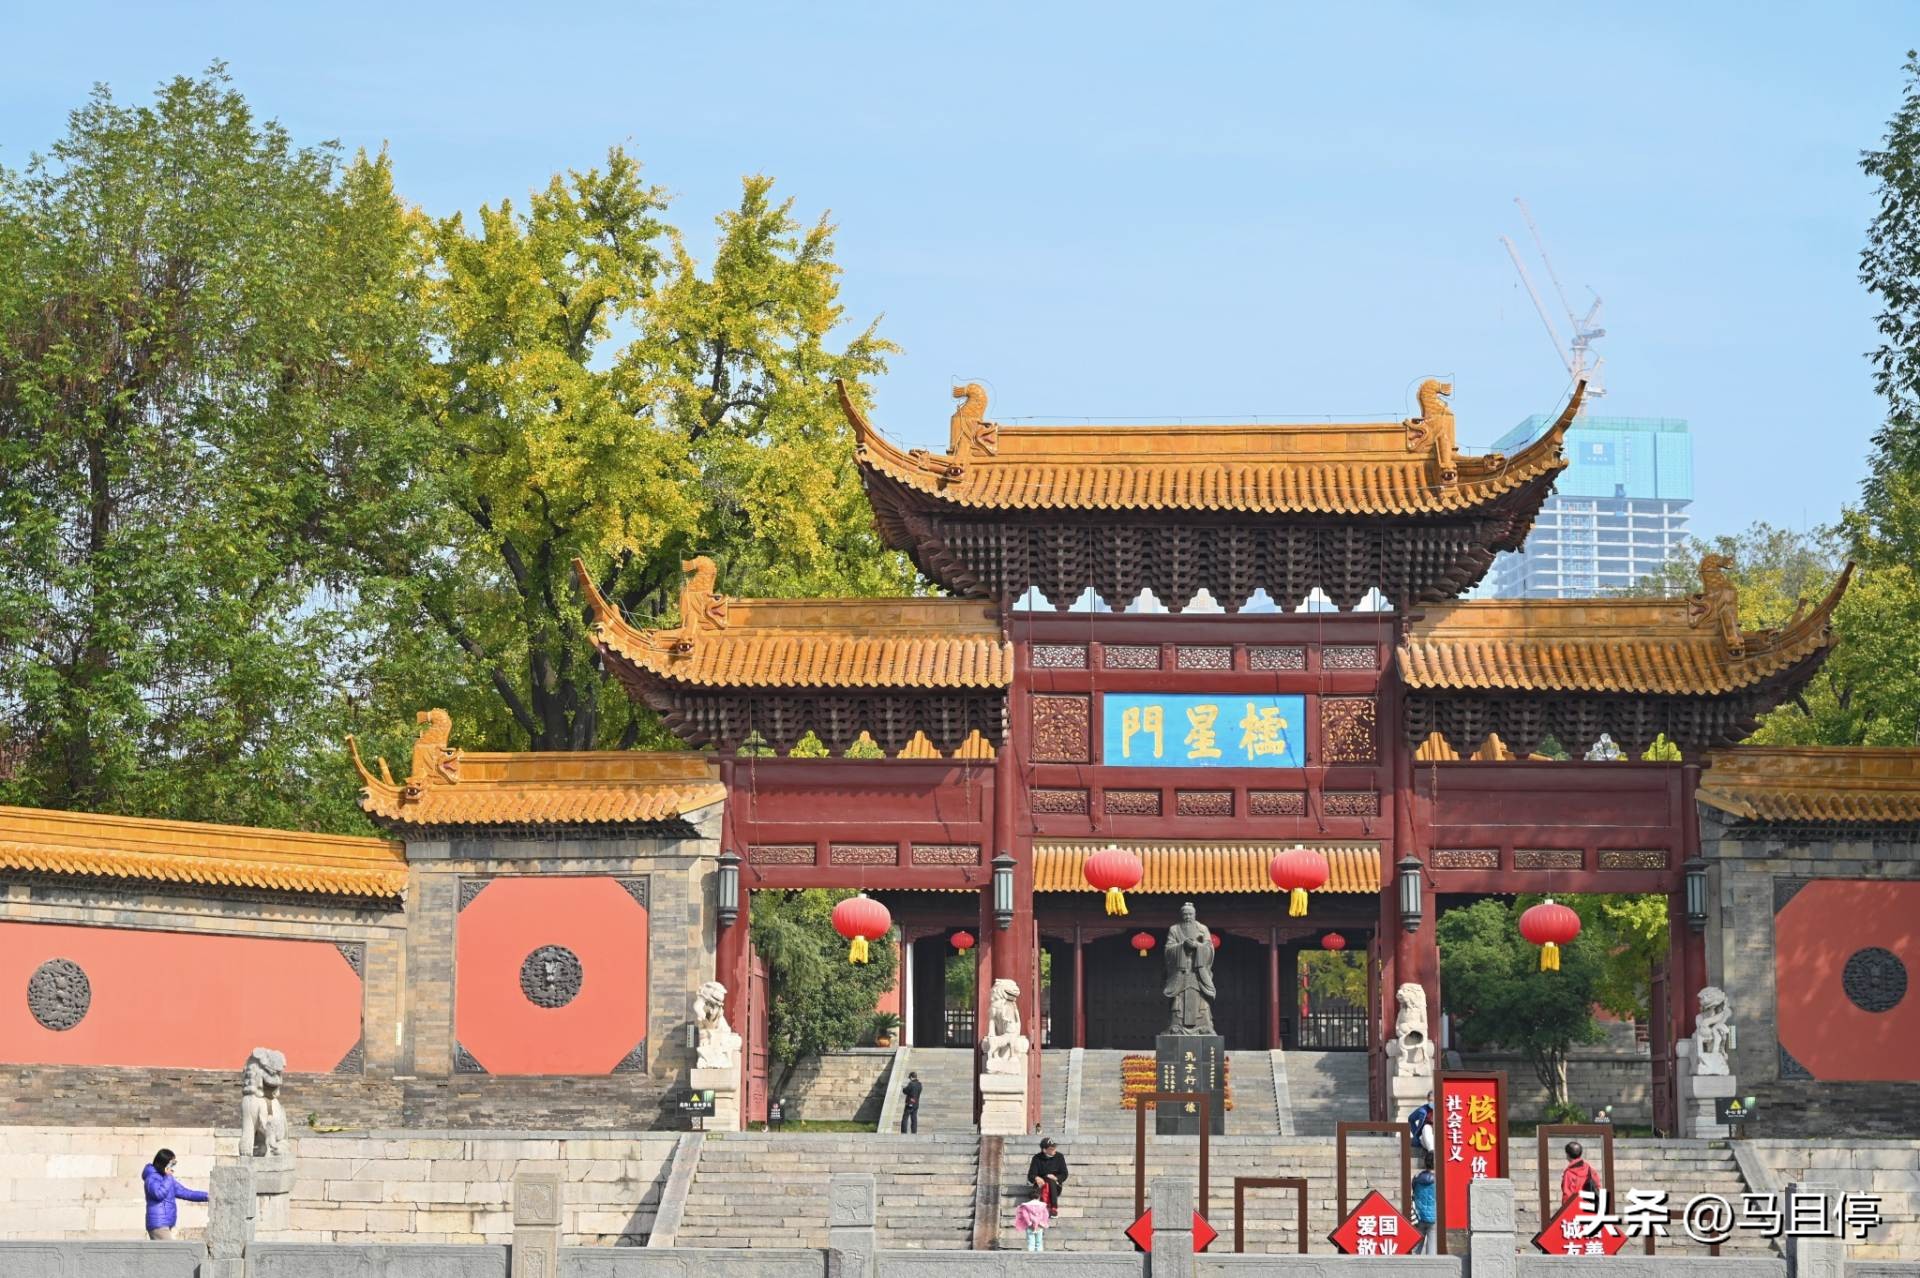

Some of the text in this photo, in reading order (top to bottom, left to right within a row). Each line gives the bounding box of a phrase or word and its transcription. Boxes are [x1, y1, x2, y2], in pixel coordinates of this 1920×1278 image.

[1446, 1095, 1463, 1161] 社会主义
[1357, 1215, 1398, 1236] 爱国
[1357, 1238, 1398, 1255] 敬业
